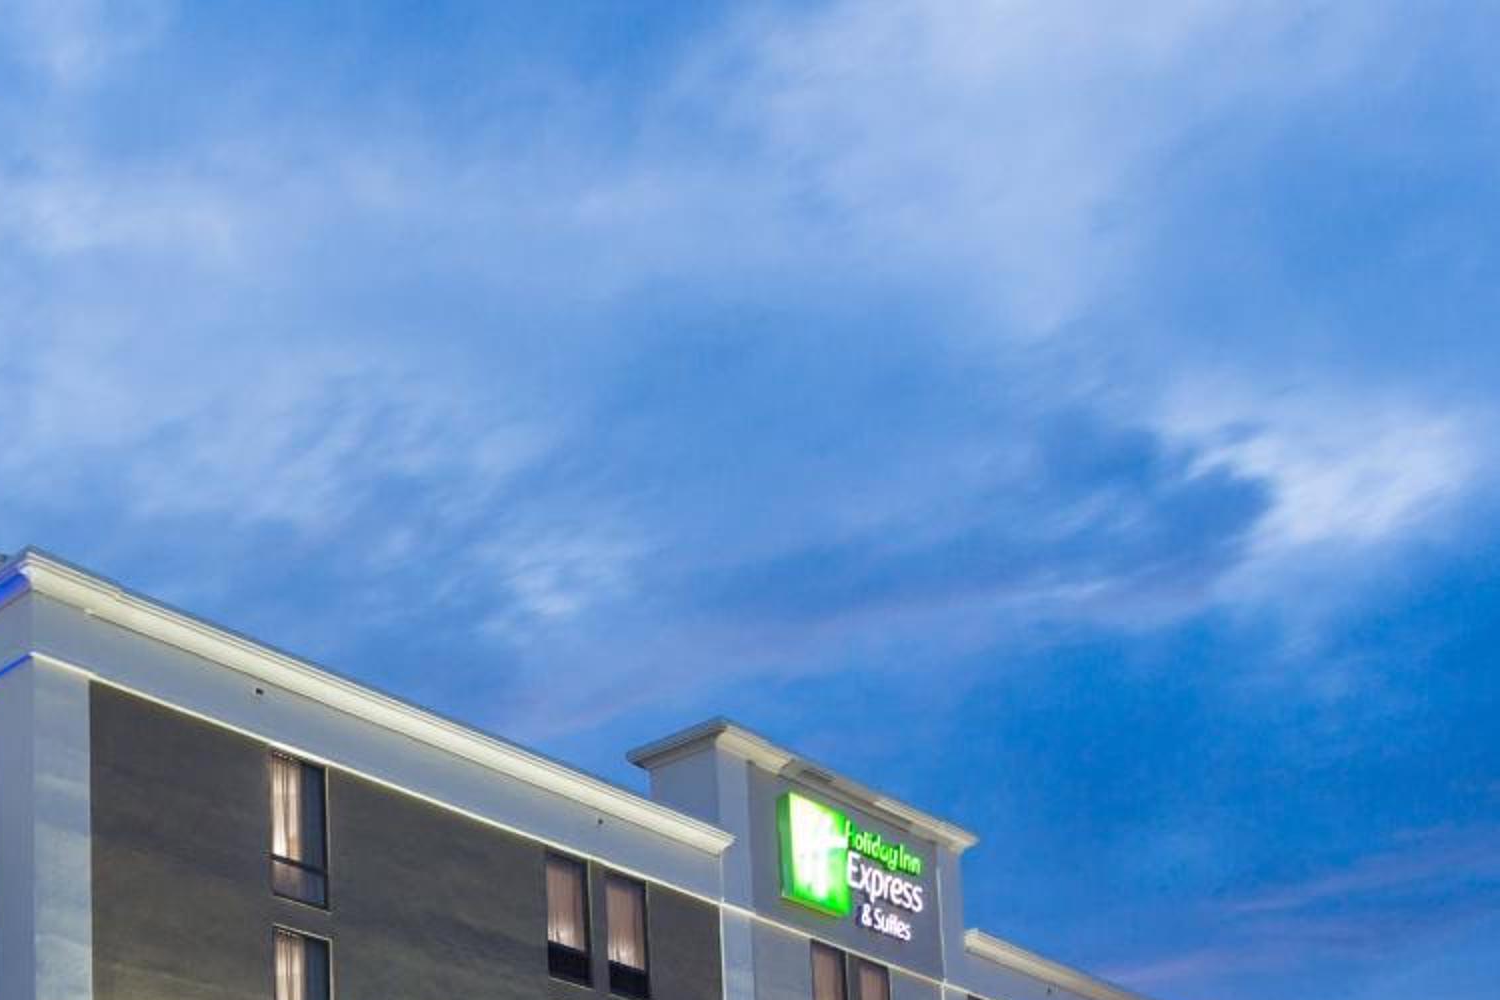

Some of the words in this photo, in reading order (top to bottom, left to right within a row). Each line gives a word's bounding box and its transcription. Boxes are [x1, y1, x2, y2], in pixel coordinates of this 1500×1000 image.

[846, 820, 898, 871] Holiday
[899, 844, 921, 874] Inn
[846, 850, 923, 912] Express
[860, 904, 873, 927] &
[873, 907, 912, 941] Suites
